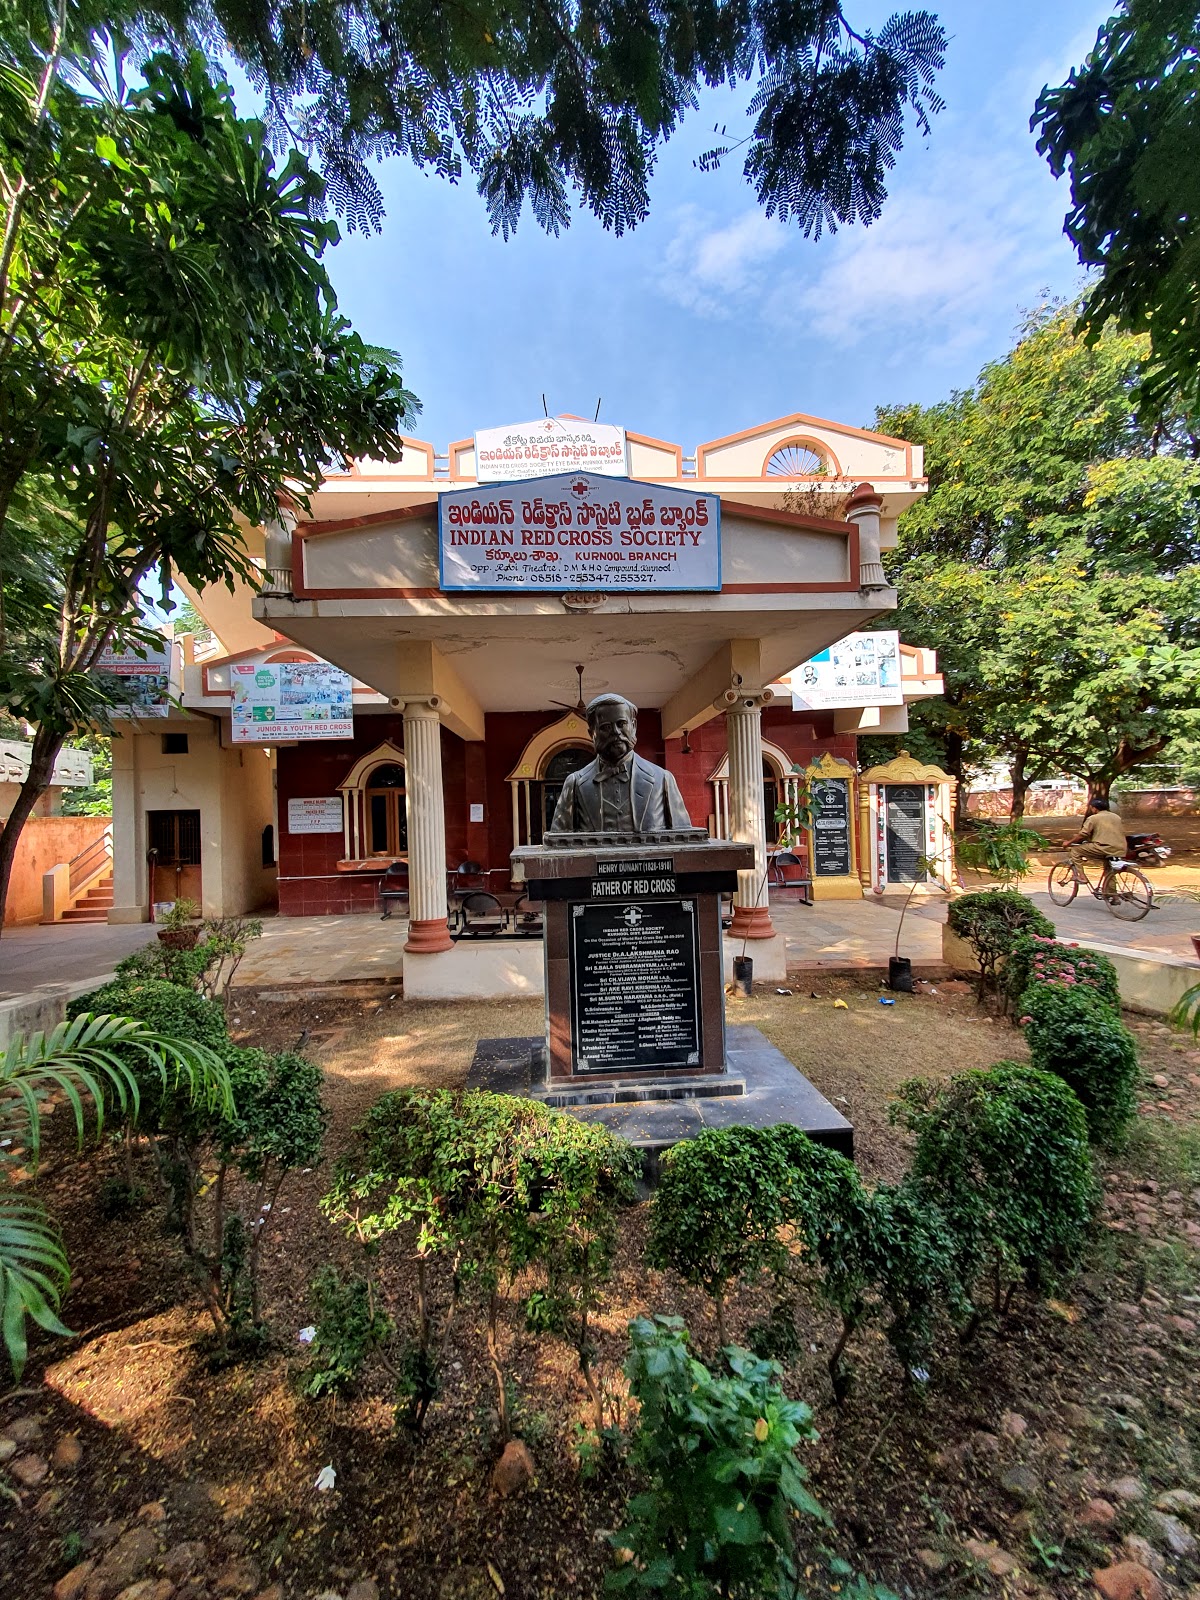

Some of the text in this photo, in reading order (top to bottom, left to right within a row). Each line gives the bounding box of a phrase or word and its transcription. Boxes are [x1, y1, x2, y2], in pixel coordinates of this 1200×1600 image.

[450, 530, 702, 546] INDIAN RED CROSS SOCIETY
[575, 552, 677, 561] KURNOOL BRANCH
[470, 564, 492, 573] Opp.
[581, 564, 587, 572] &
[598, 864, 618, 873] HENRY
[619, 862, 642, 872] DUNANT
[592, 879, 676, 896] FATHER OF RED CROSS
